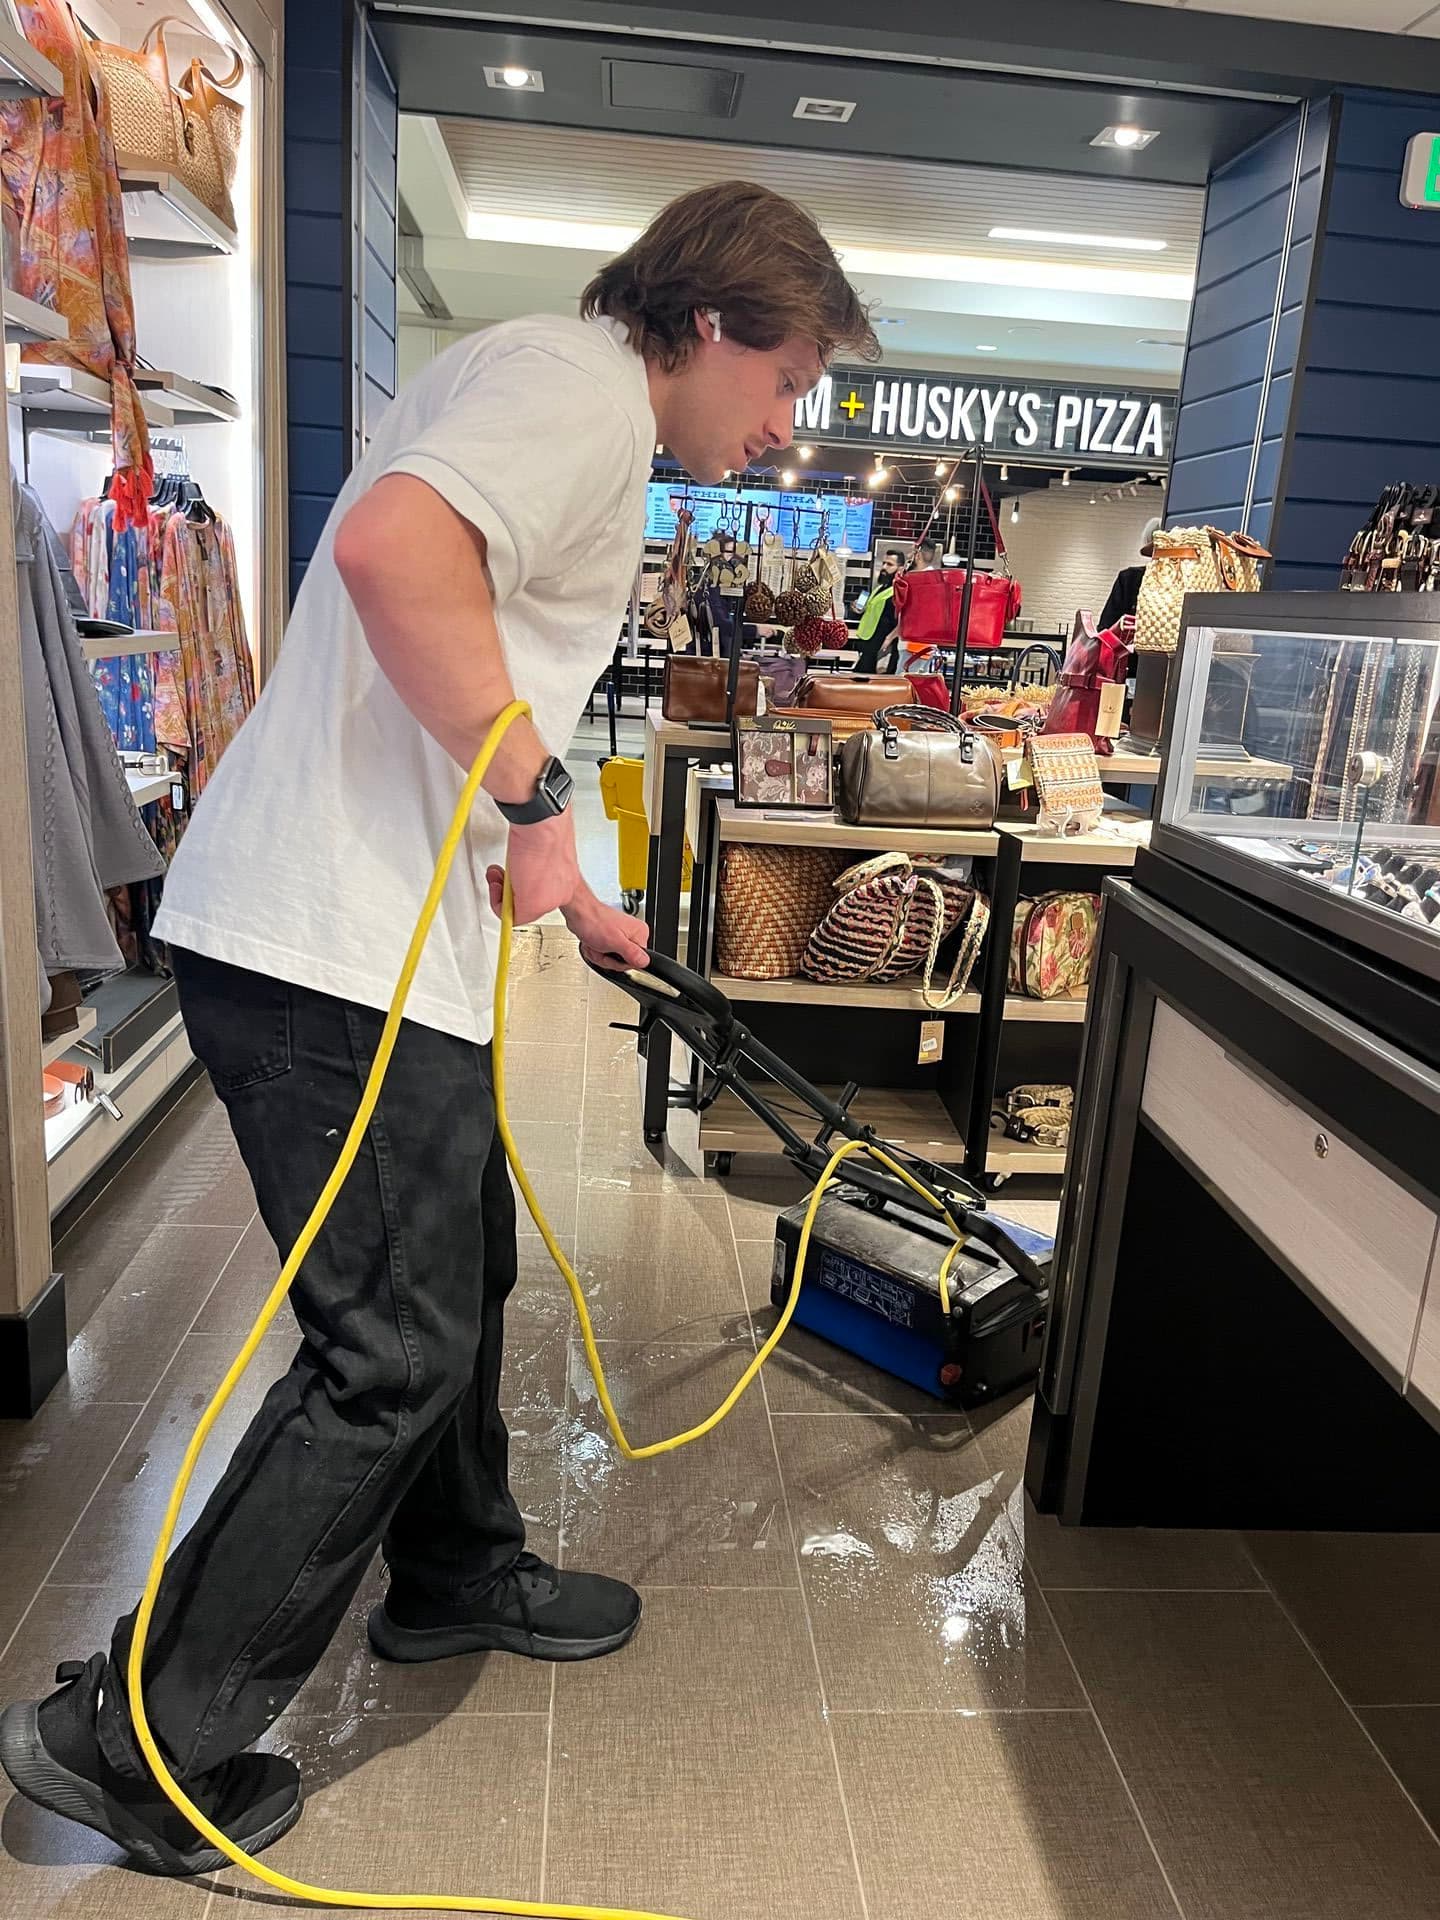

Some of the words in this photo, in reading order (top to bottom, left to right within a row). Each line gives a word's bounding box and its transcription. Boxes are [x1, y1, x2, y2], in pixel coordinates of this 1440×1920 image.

[871, 380, 1041, 446] HUSKY'S
[1054, 397, 1164, 457] PIZZA
[690, 490, 727, 499] THIS
[783, 495, 827, 504] THA
